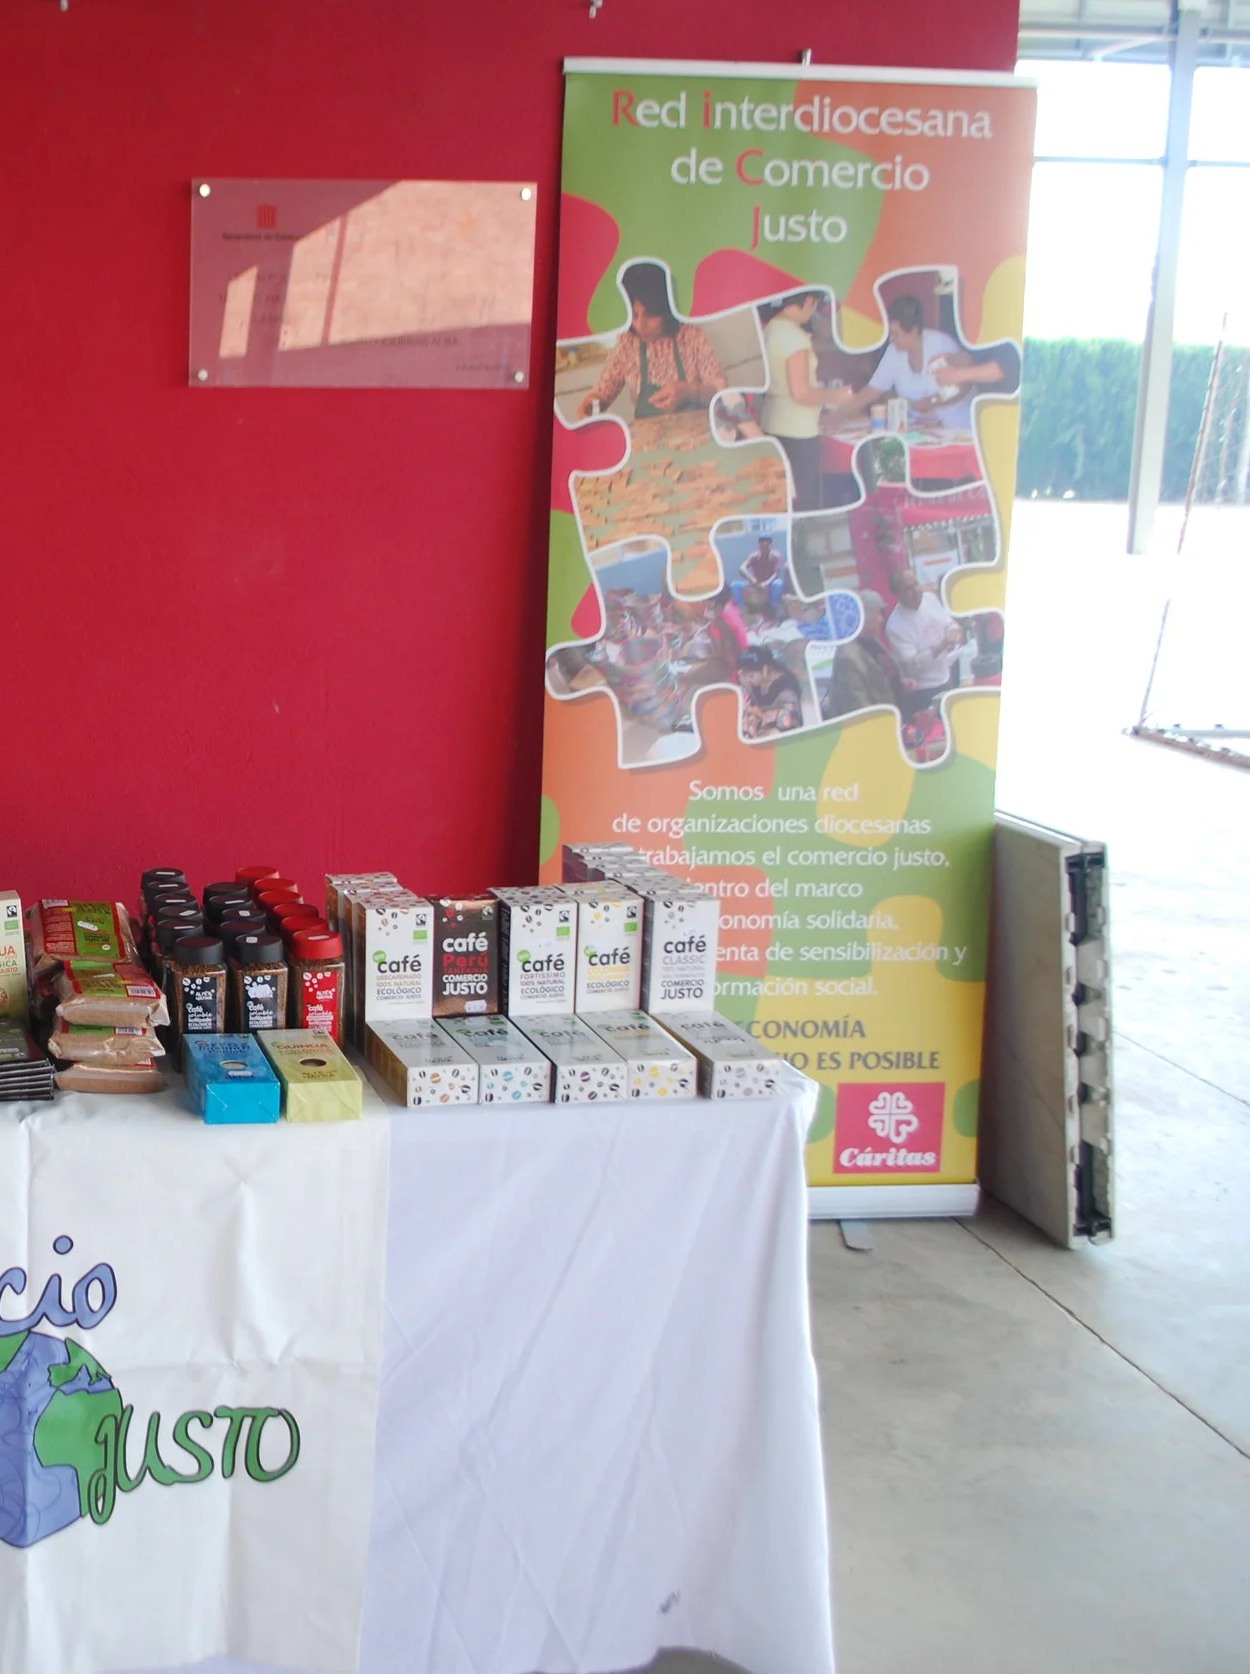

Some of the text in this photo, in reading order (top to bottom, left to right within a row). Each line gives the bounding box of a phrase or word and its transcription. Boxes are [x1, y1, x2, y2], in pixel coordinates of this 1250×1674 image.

[612, 90, 994, 139] Red interdiocesana
[670, 147, 931, 192] de Comercio
[750, 204, 848, 251] Justo
[688, 779, 860, 802] Somos una red
[612, 812, 932, 839] de organizaciones diocesanas
[762, 846, 780, 866] el
[787, 848, 887, 866] comercio
[892, 848, 950, 871] justo,
[755, 878, 789, 898] del
[795, 882, 863, 898] marco
[718, 910, 899, 930] onomía solidaria.
[442, 931, 489, 953] café
[663, 935, 707, 954] café
[442, 952, 489, 968] Perú
[522, 953, 565, 973] café
[588, 946, 631, 967] café
[662, 955, 705, 965] CLASSIC
[715, 942, 967, 965] enta de sensibilización y
[0, 966, 19, 975] JUSTO
[377, 954, 422, 974] café
[442, 973, 488, 983] COMERCIO
[520, 972, 565, 980] FORTISSIMO
[661, 979, 704, 988] COMERCIO
[442, 982, 488, 995] JUSTO
[660, 987, 703, 1000] JUSTO
[712, 977, 878, 996] ormación social.
[463, 1027, 509, 1037] café
[605, 1023, 650, 1033] café
[735, 1015, 866, 1039] CONOMÍA
[816, 1052, 841, 1070] ES
[850, 1051, 940, 1070] POSIBLE
[839, 1147, 936, 1168] Cáritas
